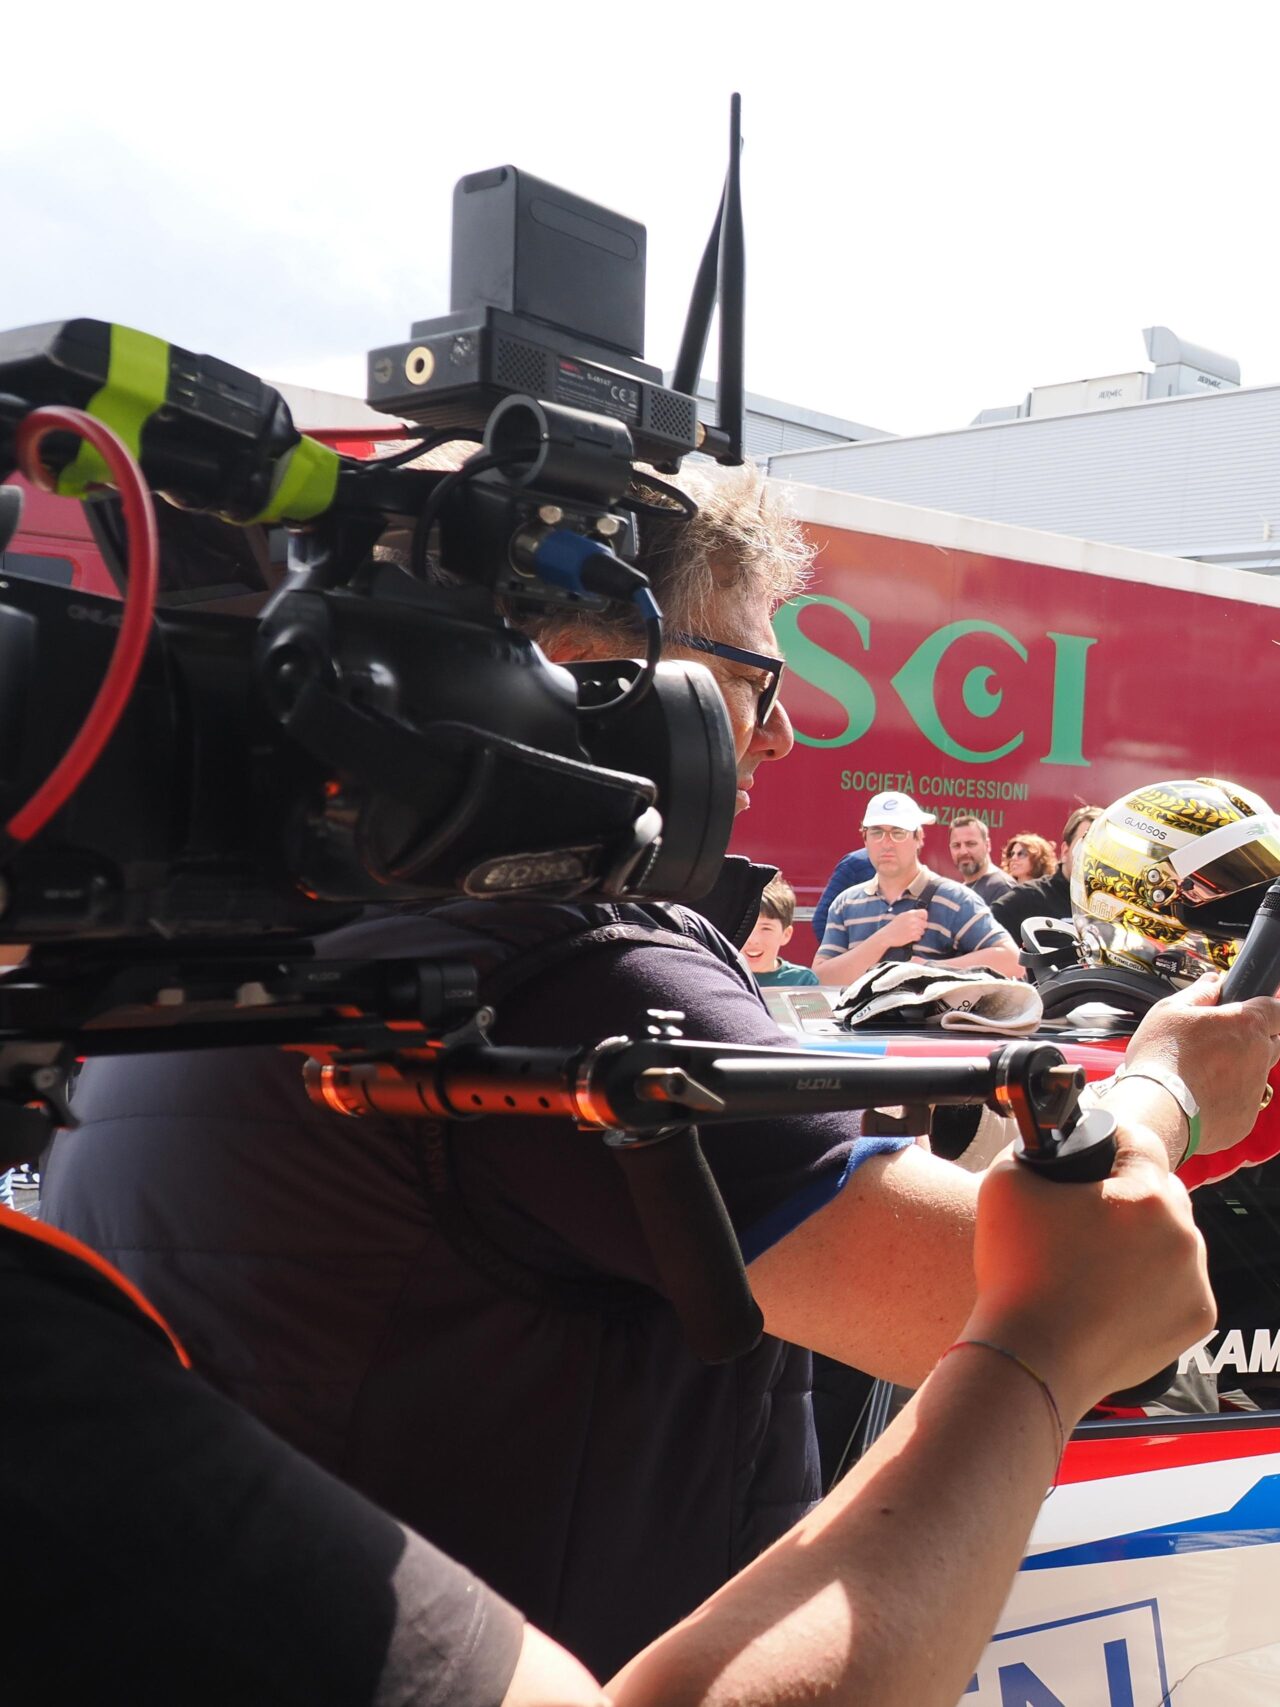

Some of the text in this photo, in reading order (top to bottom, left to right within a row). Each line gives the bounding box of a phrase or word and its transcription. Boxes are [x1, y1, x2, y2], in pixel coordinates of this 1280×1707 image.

[773, 594, 1098, 767] SCI
[841, 770, 1028, 801] SOCIETÀ CONCESSIONI
[919, 805, 1005, 828] AZIONALI
[1124, 816, 1167, 841] GLADSOS
